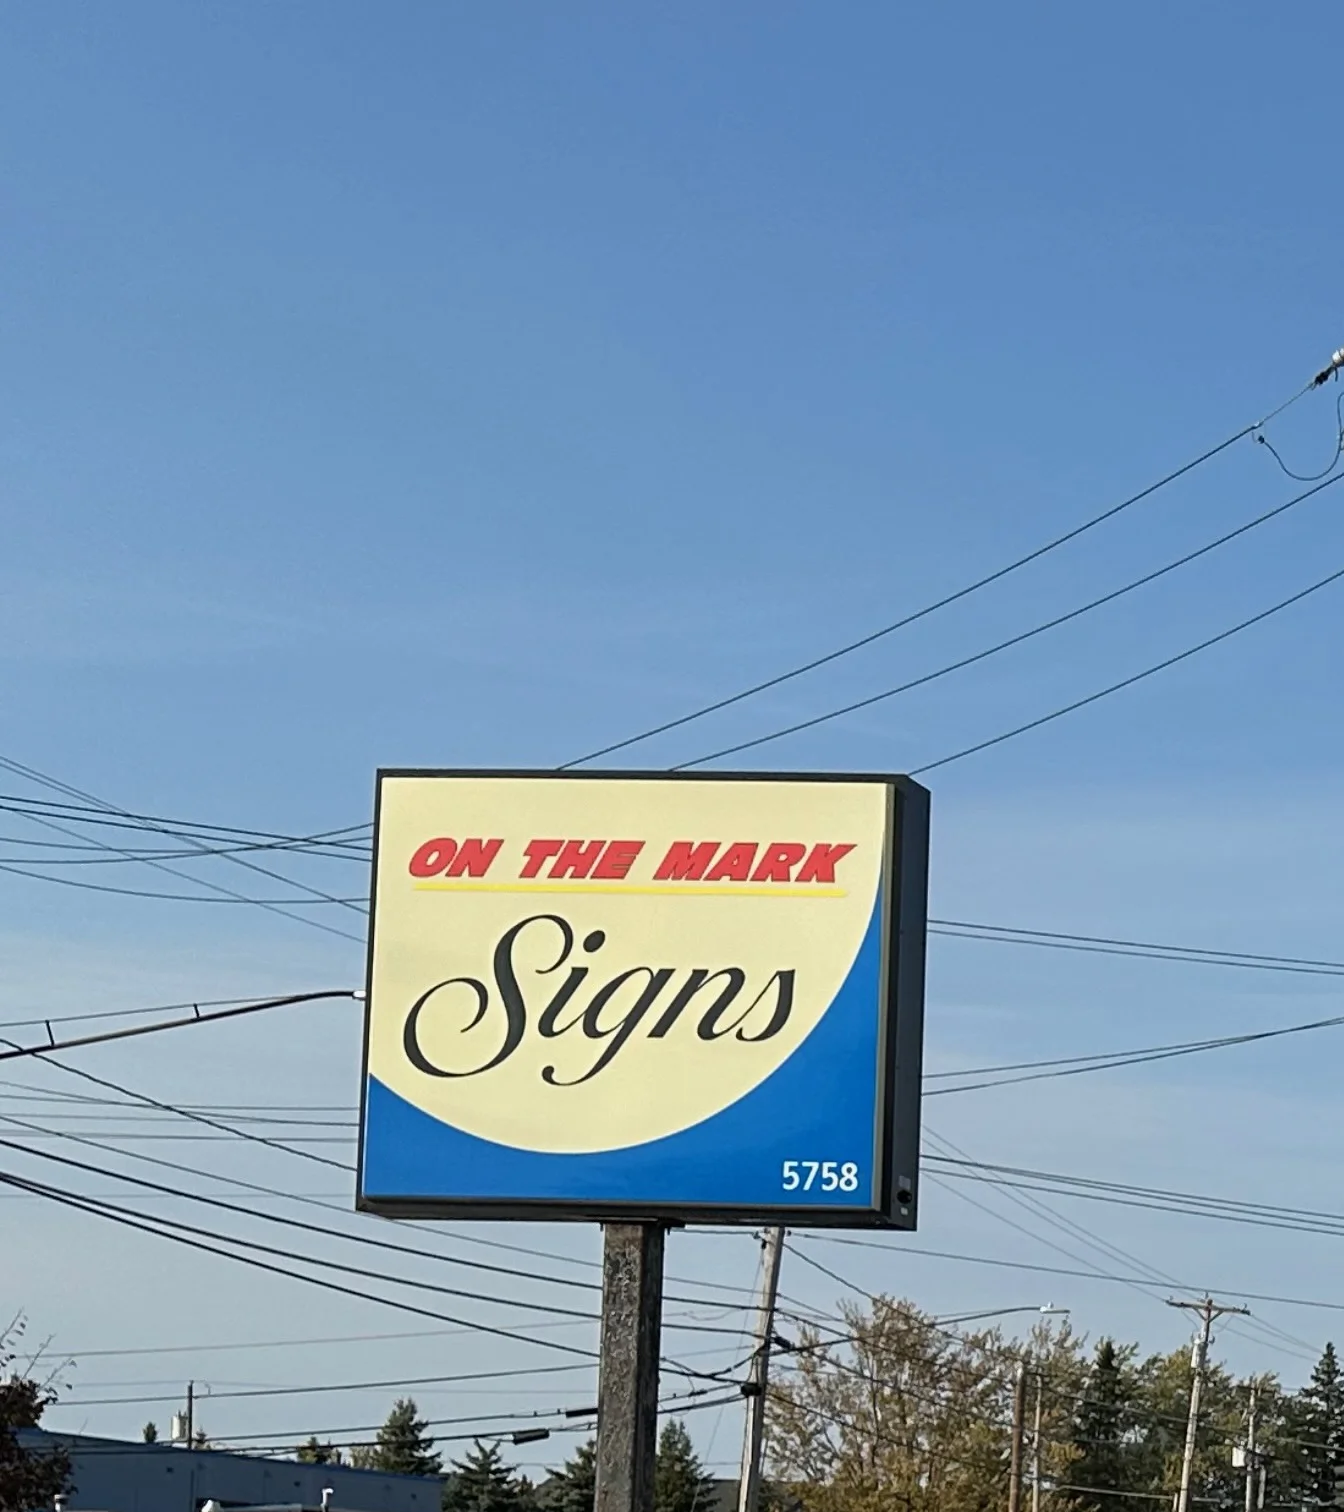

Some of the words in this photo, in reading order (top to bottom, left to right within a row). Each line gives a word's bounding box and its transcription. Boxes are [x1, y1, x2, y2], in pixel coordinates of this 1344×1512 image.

[408, 837, 504, 878] ON
[518, 839, 646, 880] THE
[652, 842, 858, 884] MARK
[402, 913, 797, 1086] Signs
[781, 1160, 859, 1192] 5758
